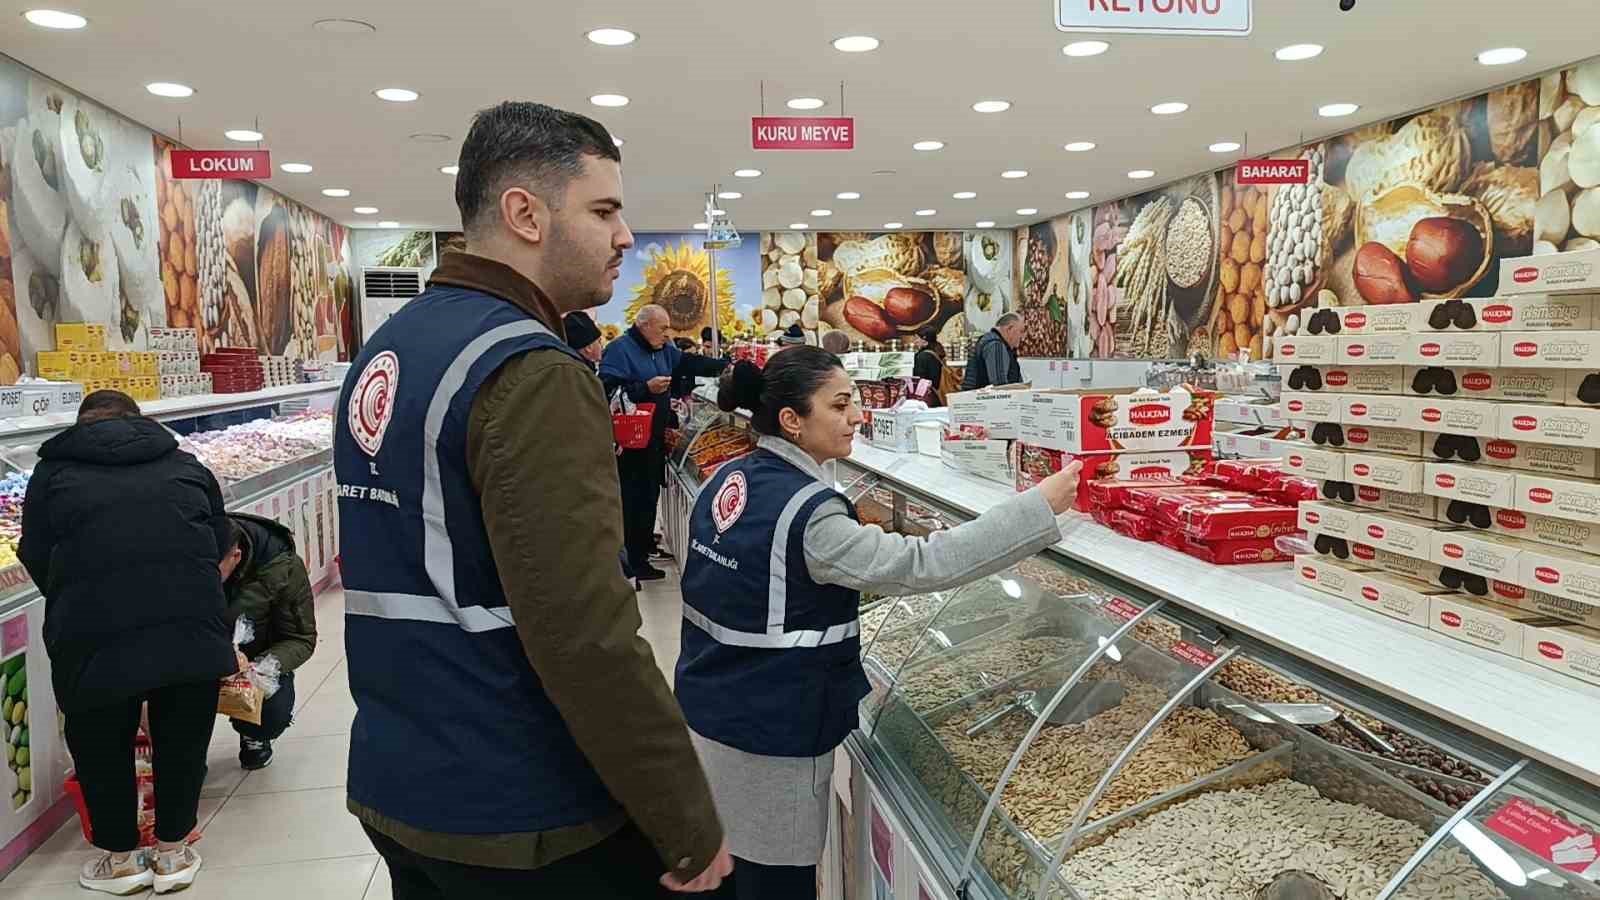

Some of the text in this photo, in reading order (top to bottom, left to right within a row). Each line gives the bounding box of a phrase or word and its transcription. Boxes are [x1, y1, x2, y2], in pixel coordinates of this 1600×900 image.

[757, 126, 849, 141] KURU MEYVE
[190, 158, 254, 171] LOKUM
[1242, 166, 1304, 178] BAHARAT
[1131, 409, 1169, 419] HALKTAN
[874, 418, 894, 438] POŞET
[1107, 430, 1156, 440] ACIBADEM
